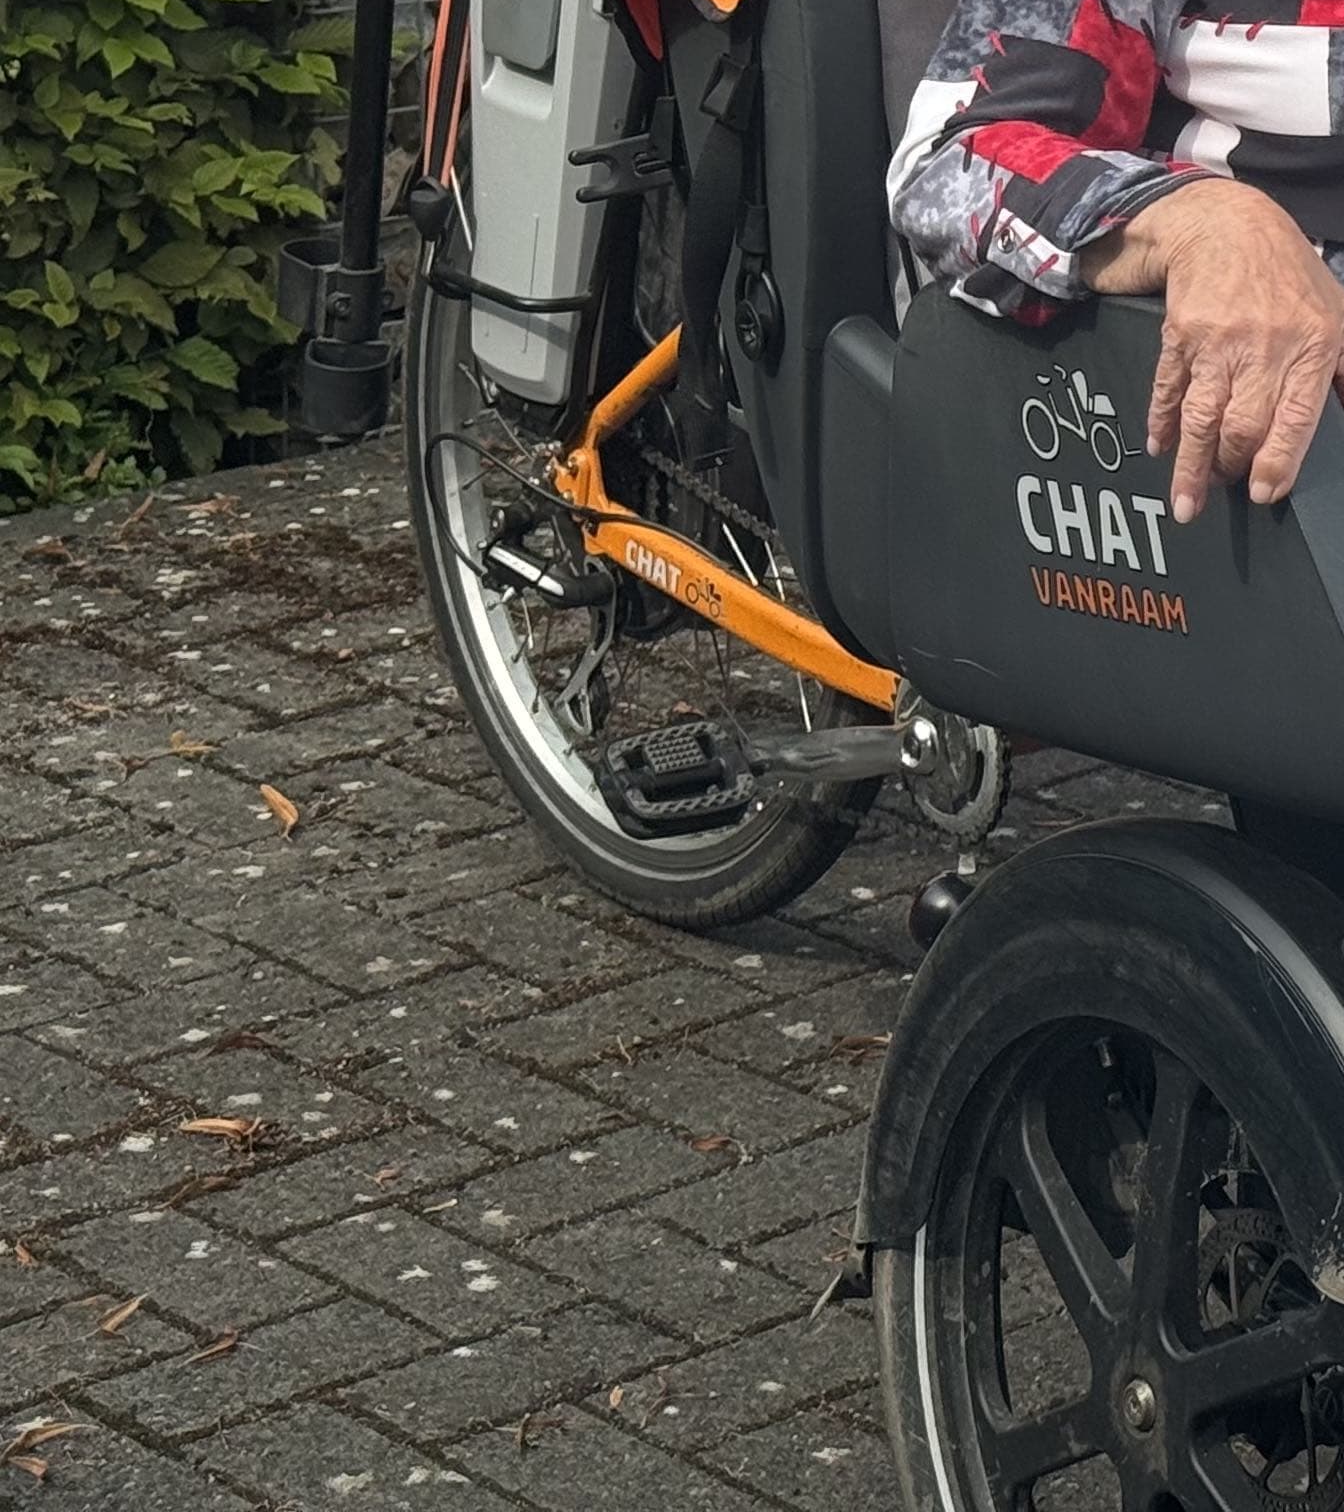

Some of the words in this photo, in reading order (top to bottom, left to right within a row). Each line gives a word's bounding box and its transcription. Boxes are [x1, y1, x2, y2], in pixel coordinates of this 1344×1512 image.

[1015, 473, 1169, 577] CHAT
[625, 538, 682, 596] CHAT
[1029, 565, 1190, 636] VANRAAM
